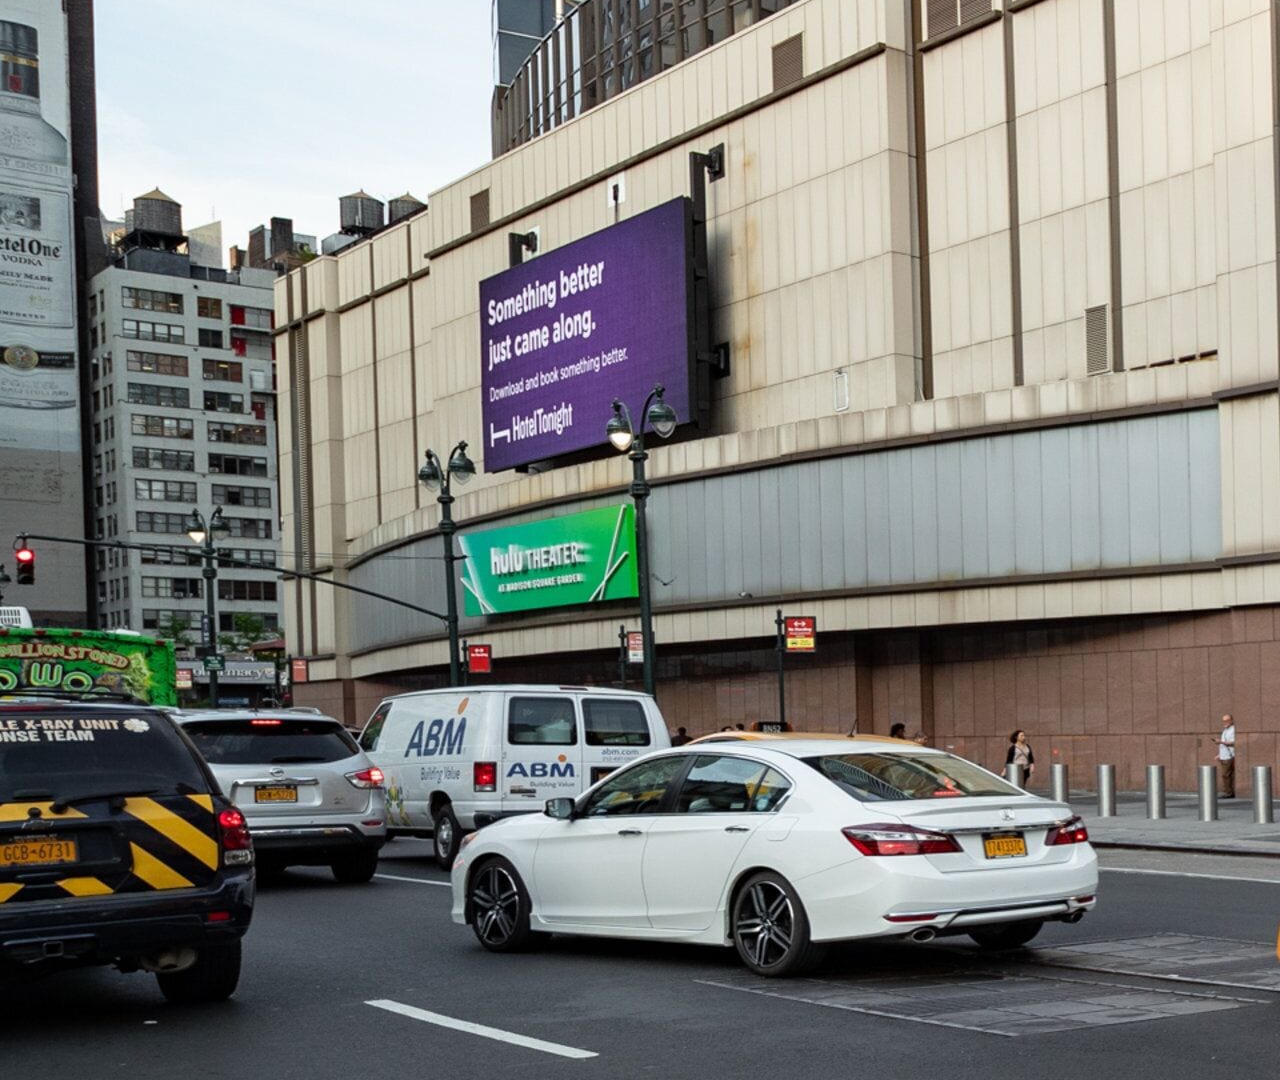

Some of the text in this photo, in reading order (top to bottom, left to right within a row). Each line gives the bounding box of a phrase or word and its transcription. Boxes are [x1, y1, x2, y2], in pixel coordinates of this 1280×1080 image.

[28, 240, 60, 258] One
[2, 254, 43, 266] VODKA
[488, 261, 604, 325] Something better
[488, 309, 596, 370] just came along.
[490, 347, 628, 402] Download and book something better.
[512, 402, 573, 441] HotelTonight
[490, 542, 581, 575] hulu THEATER
[24, 720, 74, 731] X-RAY
[80, 720, 120, 731] UNIT
[0, 730, 95, 743] NSE TEAM
[404, 717, 467, 758] ABM
[601, 747, 640, 757] abm.com
[506, 762, 576, 778] ABM
[530, 780, 576, 789] Building Value
